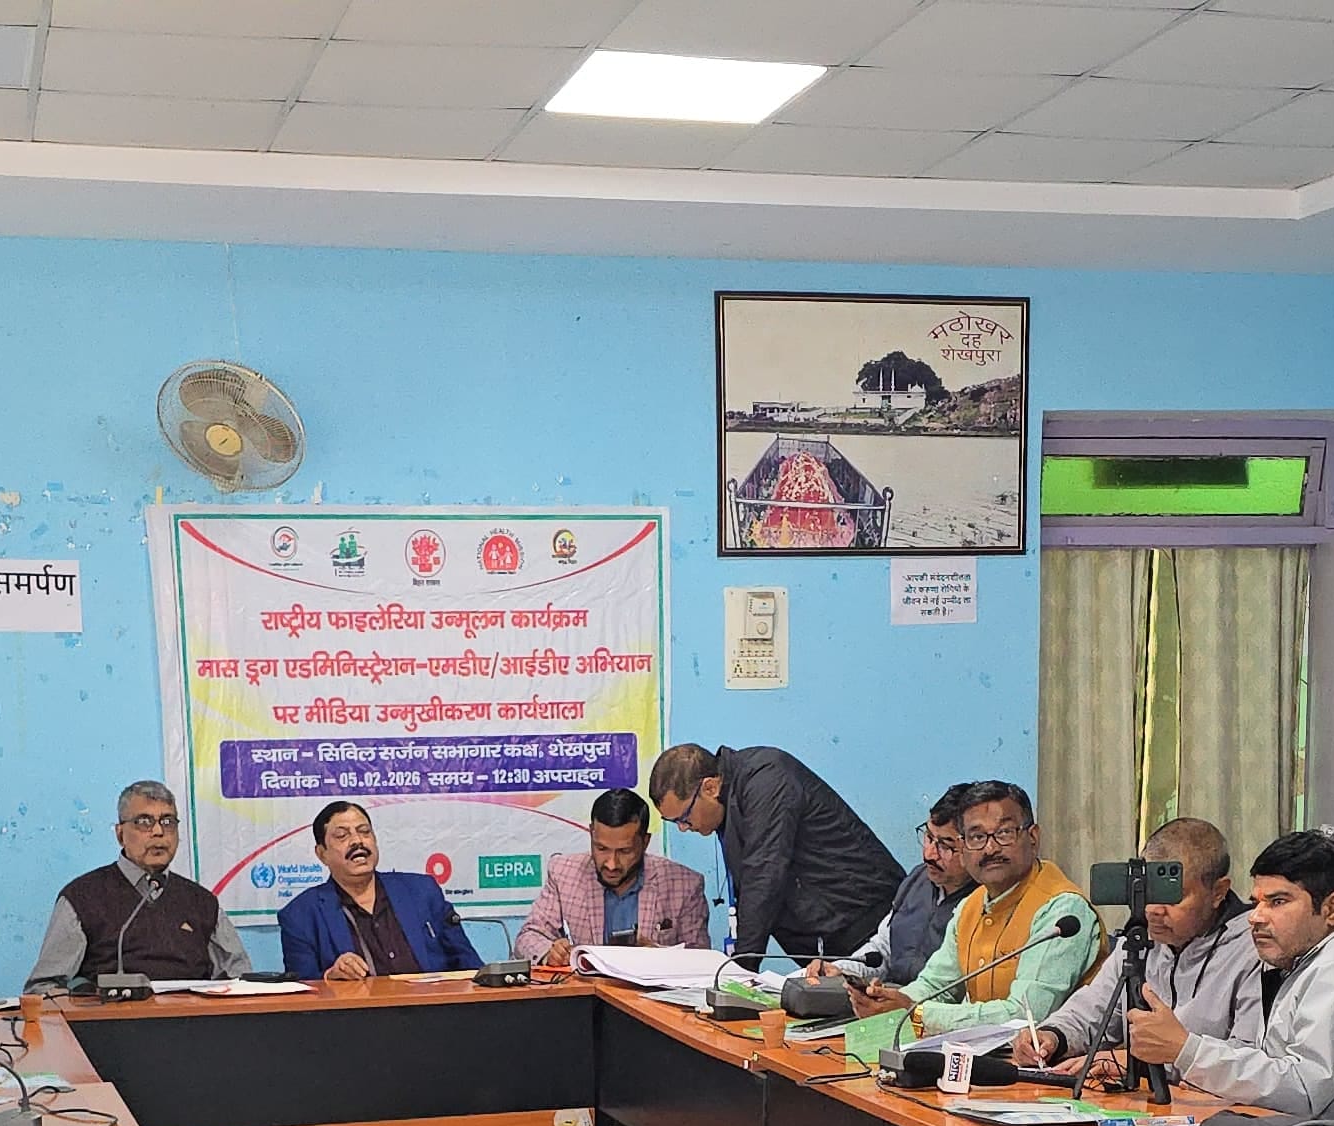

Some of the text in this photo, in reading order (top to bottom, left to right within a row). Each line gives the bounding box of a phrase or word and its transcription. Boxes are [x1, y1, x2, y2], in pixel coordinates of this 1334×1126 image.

[927, 310, 1014, 345] मठोखर
[960, 332, 982, 348] दह
[940, 344, 1001, 366] शेखपुरा
[260, 602, 589, 639] राष्ट्रीय फाइलेरिया उन्मूलन कार्यक्रम
[196, 659, 239, 678] मास
[575, 647, 652, 673] अभियान
[272, 694, 586, 732] पर मीडिया उन्मुखीकरण कार्यशाला
[251, 748, 299, 763] स्थान
[318, 743, 377, 762] सिविल
[378, 742, 429, 761] सर्जन
[431, 744, 502, 760] सभागार
[548, 738, 612, 763] शेखपुरा
[260, 770, 321, 790] दिनांक
[339, 770, 421, 788] 05.02.2026
[427, 770, 474, 786] समय
[492, 768, 530, 784] 12:30
[277, 864, 322, 873] World Health
[483, 861, 535, 878] LEPRA
